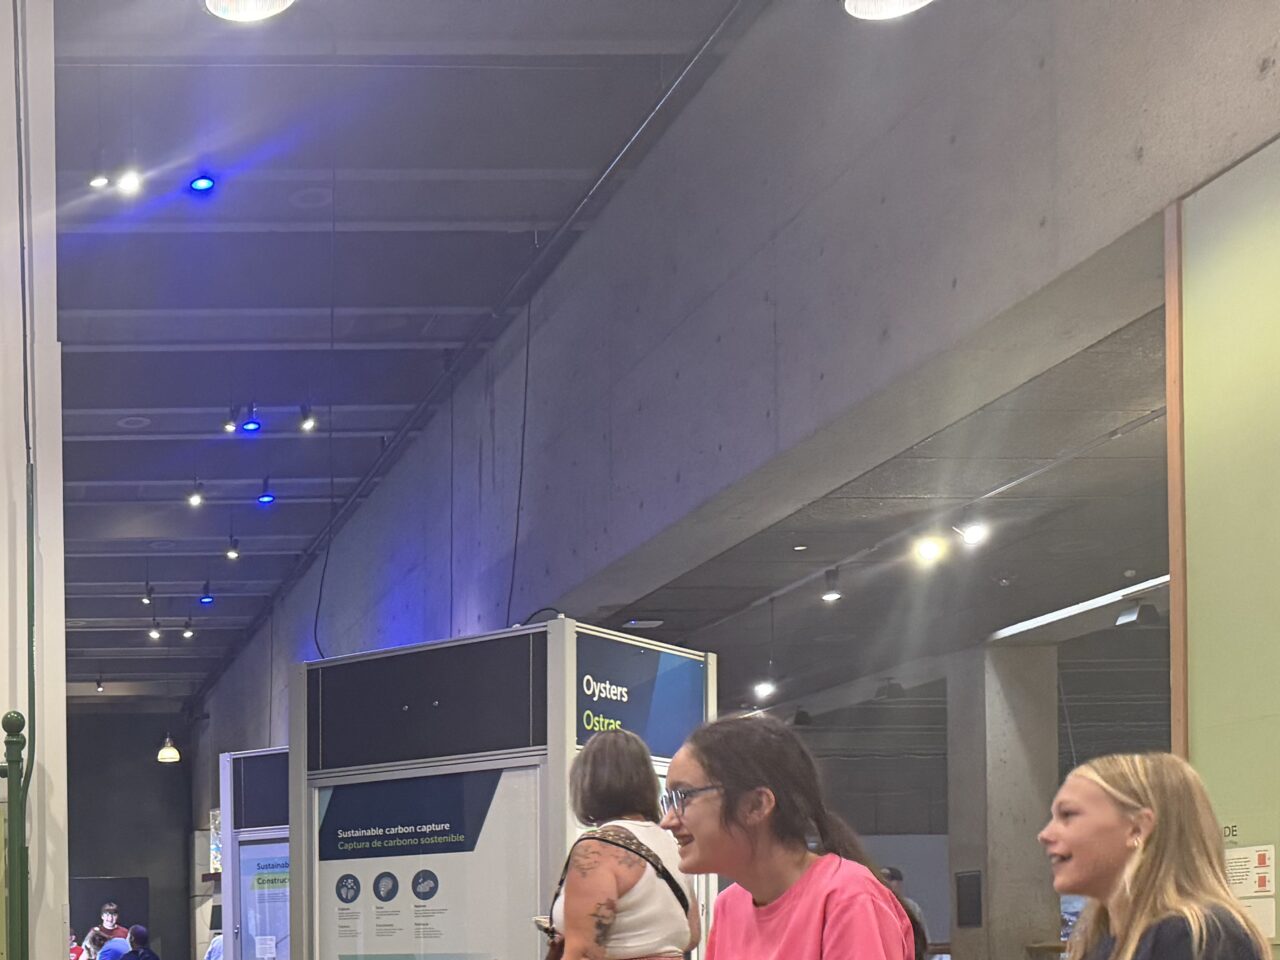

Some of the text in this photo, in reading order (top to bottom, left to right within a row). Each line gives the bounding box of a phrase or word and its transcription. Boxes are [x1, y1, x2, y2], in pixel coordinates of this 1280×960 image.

[583, 674, 628, 702] Oysters
[583, 709, 622, 731] Ostras
[337, 823, 450, 838] Sustainable carbon capture
[337, 834, 465, 851] Captura de carbono sostenible
